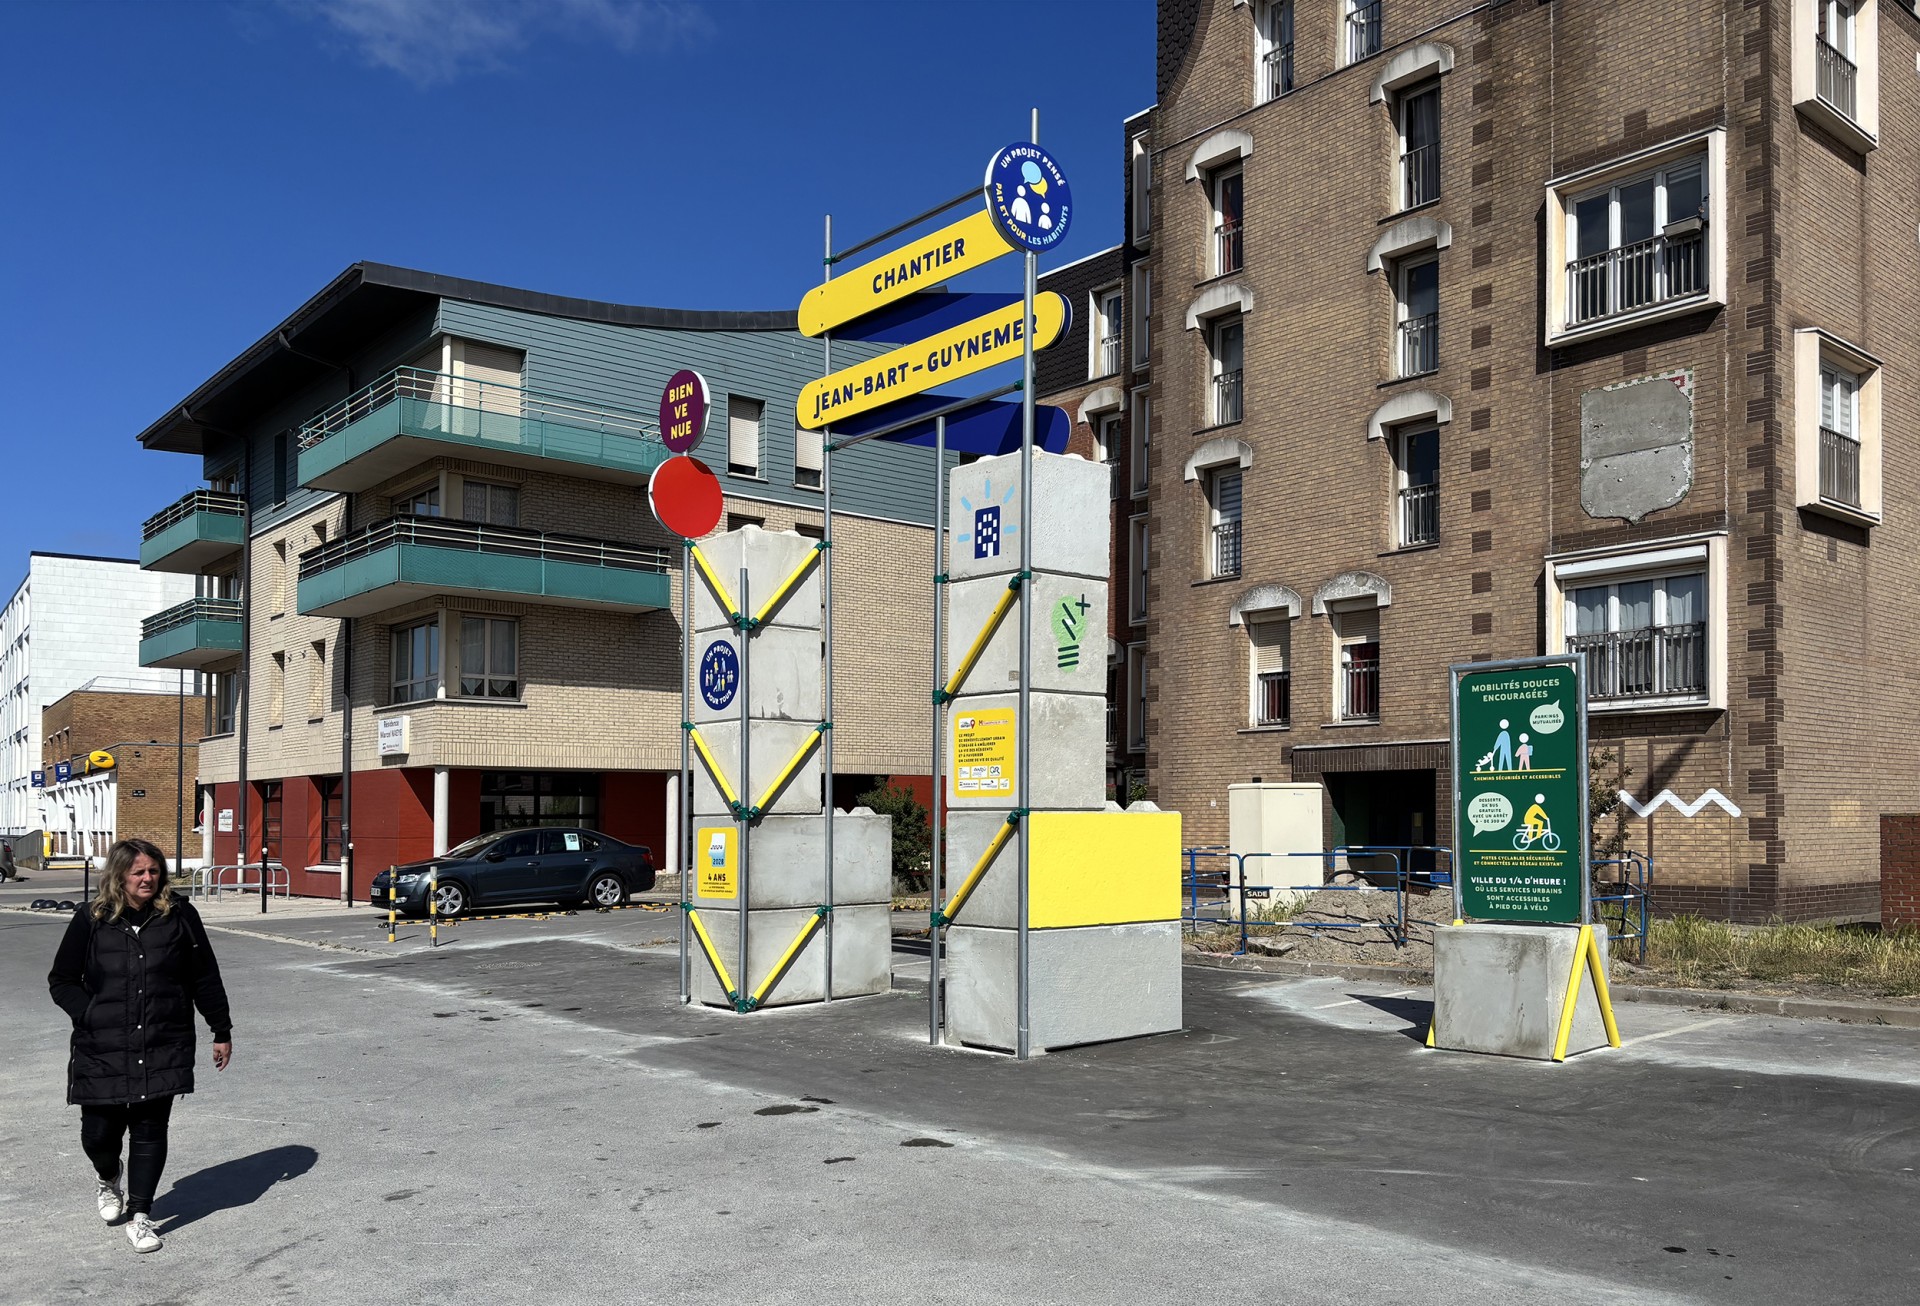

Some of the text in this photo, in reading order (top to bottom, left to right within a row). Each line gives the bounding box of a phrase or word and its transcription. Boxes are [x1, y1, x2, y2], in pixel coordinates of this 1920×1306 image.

[1001, 148, 1065, 186] UN PROJET PENSÉ
[1000, 205, 1009, 217] ET
[1007, 218, 1026, 240] POUR
[1028, 236, 1041, 245] LES
[1042, 206, 1068, 244] HABITANTS
[873, 238, 965, 294] CHANTIER
[813, 362, 909, 419] JEAN-BART
[927, 315, 1038, 373] GUYNEMER
[669, 382, 693, 403] BIEN
[674, 403, 687, 419] VE
[671, 420, 691, 439] NUE
[706, 645, 732, 662] UN PROJET
[1471, 679, 1560, 692] MOBILITÉS DOUCES
[706, 690, 732, 704] POUR TOUS
[1483, 689, 1548, 702] ENCOURAGÉES
[708, 873, 712, 881] 4
[1525, 876, 1560, 885] D'HEURE
[1530, 903, 1548, 911] VÉLO
